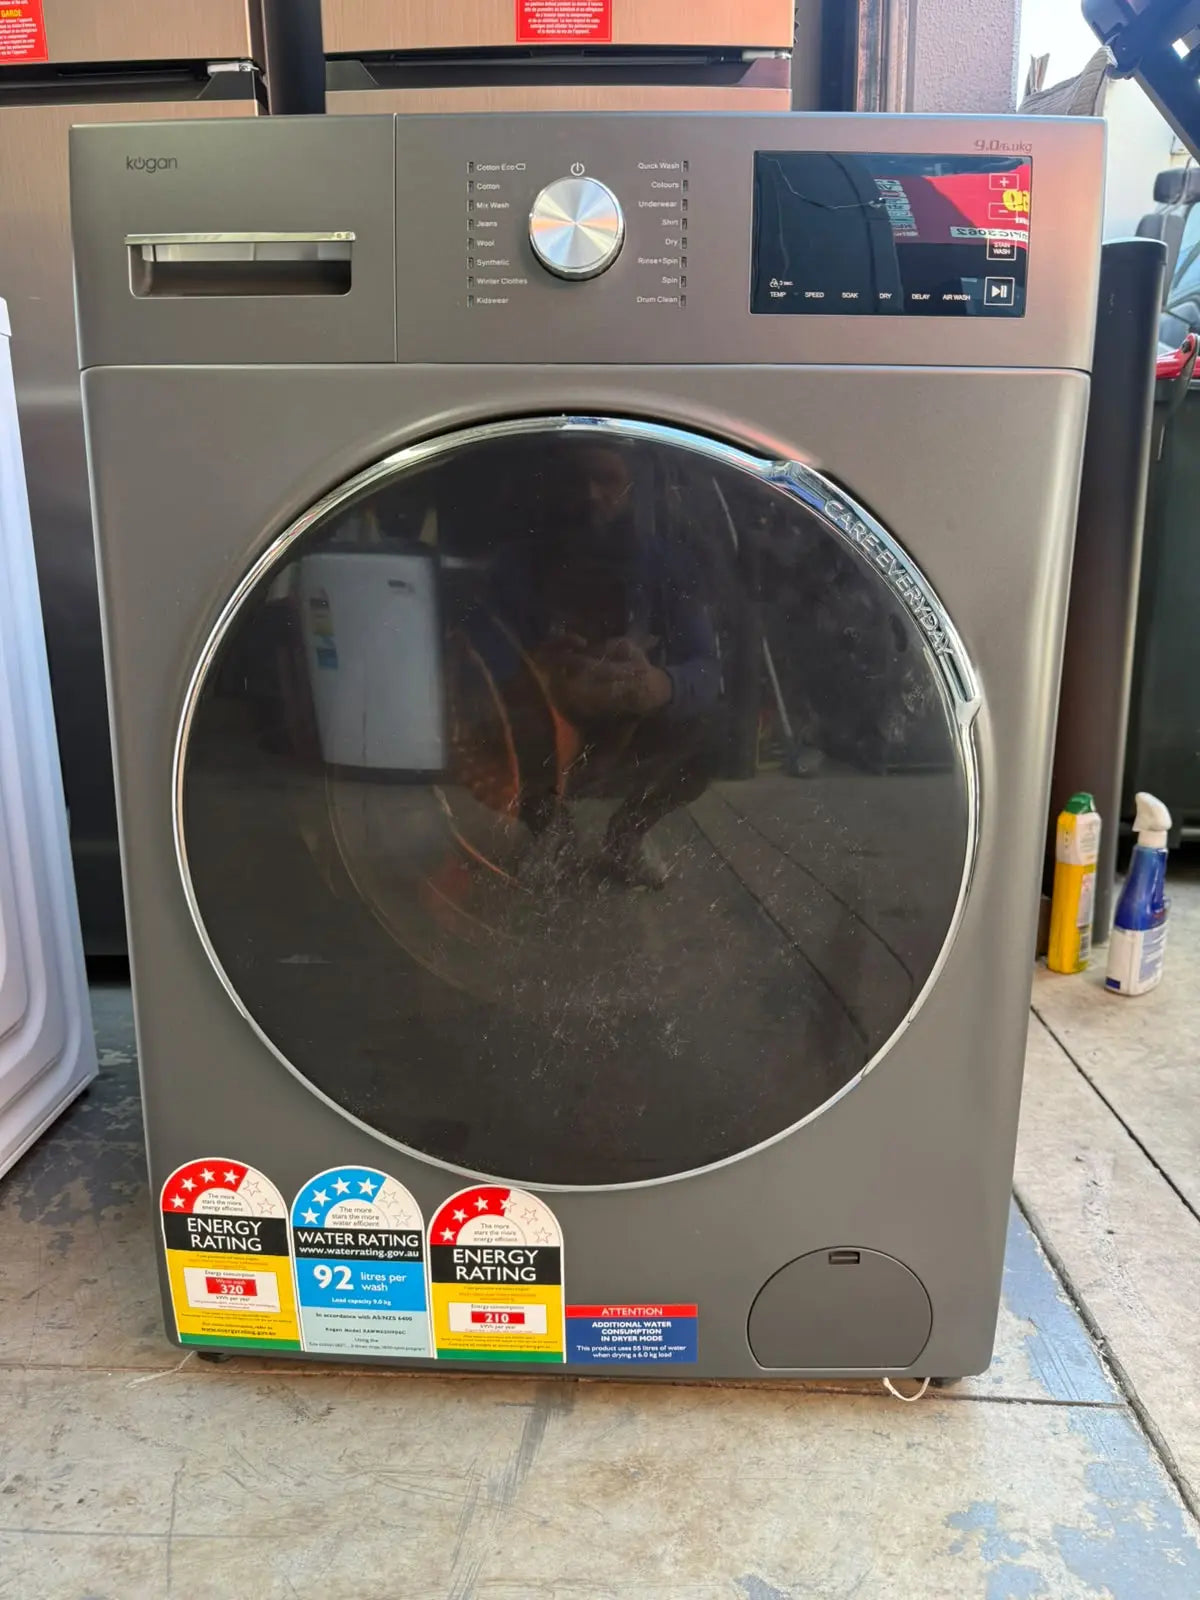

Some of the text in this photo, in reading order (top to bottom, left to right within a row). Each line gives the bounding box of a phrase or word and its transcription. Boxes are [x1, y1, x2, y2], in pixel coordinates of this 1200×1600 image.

[126, 155, 178, 174] kogan
[638, 162, 658, 170] Quick
[665, 238, 678, 247] Dry
[476, 259, 510, 267] Synthetic
[662, 276, 678, 284] Spin
[825, 500, 953, 656] CARE EVERYDAY
[187, 1217, 262, 1236] ENERGY
[191, 1234, 262, 1251] RATING
[297, 1231, 419, 1247] WATER RATING
[299, 1246, 419, 1259] www.waterrating.gov.au
[453, 1248, 539, 1265] ENERGY
[313, 1264, 355, 1291] 92
[360, 1271, 407, 1284] litres per
[456, 1266, 537, 1281] RATING
[221, 1284, 244, 1295] 320
[361, 1283, 388, 1292] wash
[601, 1307, 663, 1316] ATTENTION
[485, 1313, 510, 1323] 210
[592, 1321, 672, 1329] ADDITIONAL WATER
[591, 1345, 617, 1353] product
